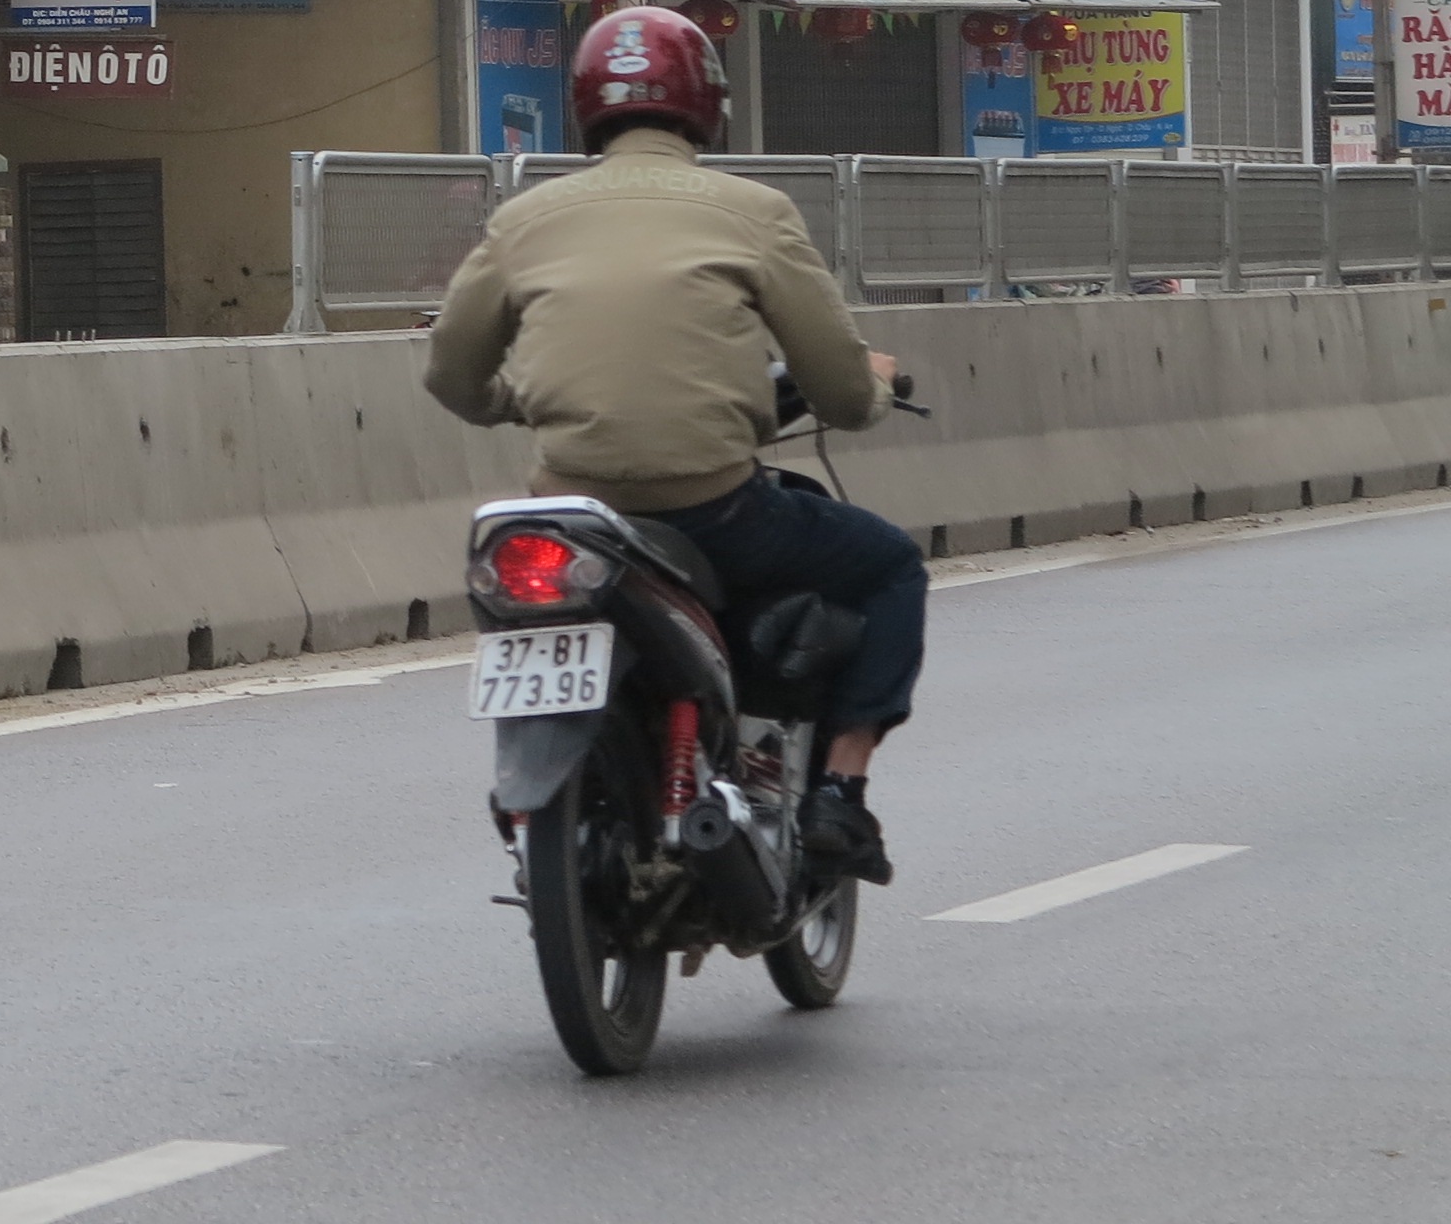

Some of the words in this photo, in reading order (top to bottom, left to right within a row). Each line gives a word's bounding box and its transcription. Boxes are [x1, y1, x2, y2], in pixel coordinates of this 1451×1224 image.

[1062, 30, 1097, 74] HỤ
[1102, 19, 1170, 65] TÙNG
[1401, 7, 1451, 43] RĂ
[1051, 81, 1093, 116] XE
[1099, 69, 1170, 114] MÁY
[494, 632, 590, 672] 37-B1
[479, 669, 598, 713] 773.96
